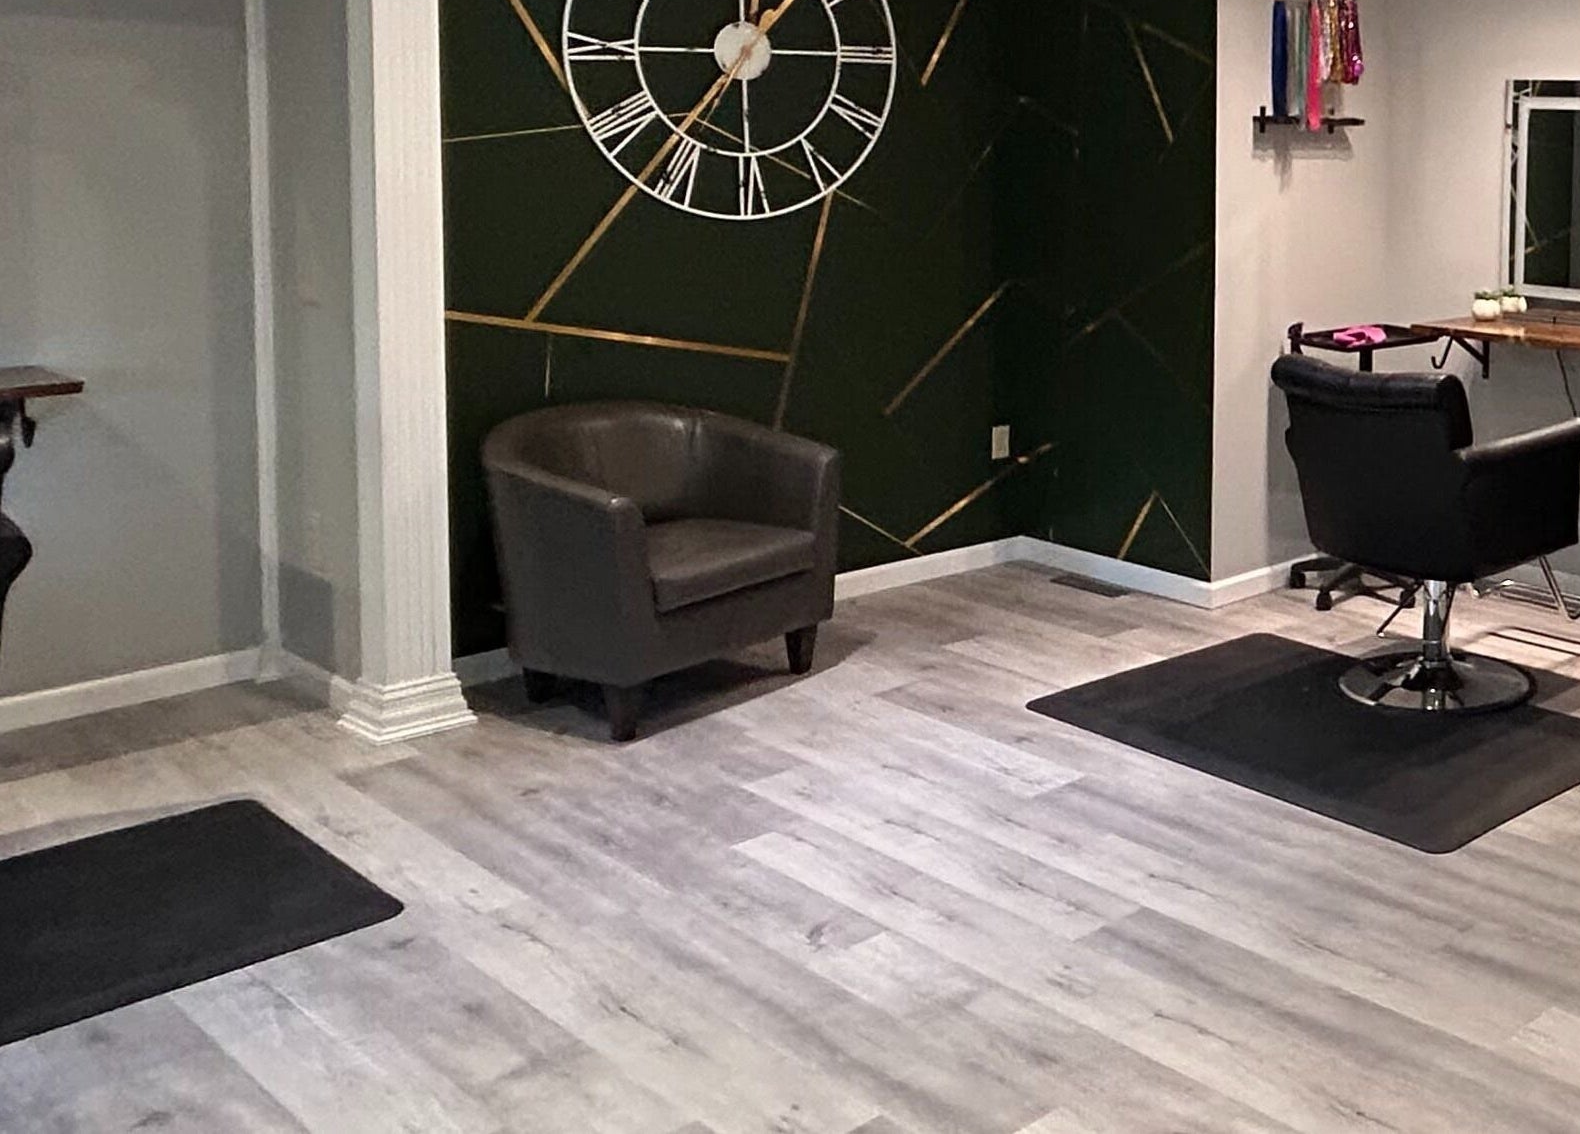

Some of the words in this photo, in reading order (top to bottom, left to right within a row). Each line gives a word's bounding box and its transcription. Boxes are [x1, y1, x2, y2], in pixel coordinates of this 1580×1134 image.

[566, 30, 637, 61] IX
[839, 44, 894, 65] III
[586, 91, 659, 160] VIII
[826, 92, 886, 141] IV
[651, 137, 701, 210] VII
[737, 154, 770, 217] VI
[800, 136, 845, 193] V
